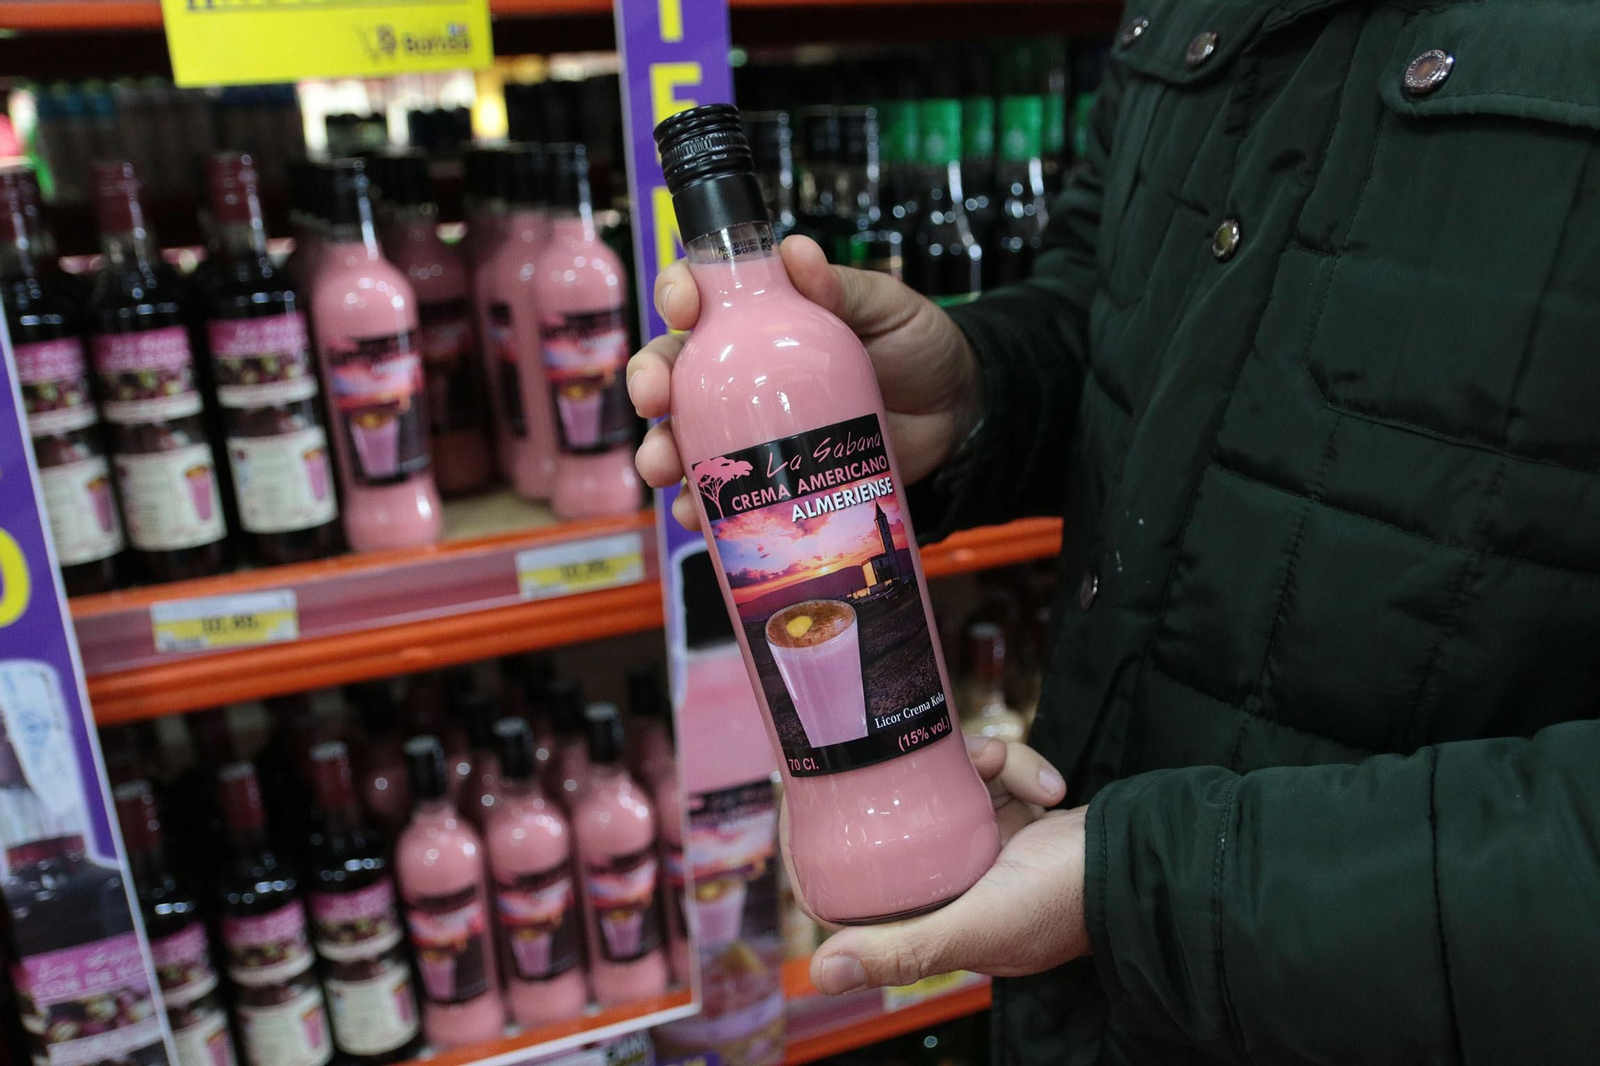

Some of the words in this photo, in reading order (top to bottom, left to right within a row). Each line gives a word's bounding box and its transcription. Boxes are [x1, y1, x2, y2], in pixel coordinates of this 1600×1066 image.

[766, 452, 802, 478] La
[813, 431, 881, 463] Sabana
[731, 484, 791, 511] CREMA
[797, 455, 887, 494] AMERICANO
[792, 476, 893, 522] ALMERIENSE
[875, 713, 902, 729] Licor
[903, 701, 931, 719] Crema
[930, 691, 945, 707] Kola
[898, 727, 930, 752] (15%
[930, 714, 950, 735] vol.)
[788, 758, 801, 771] 70
